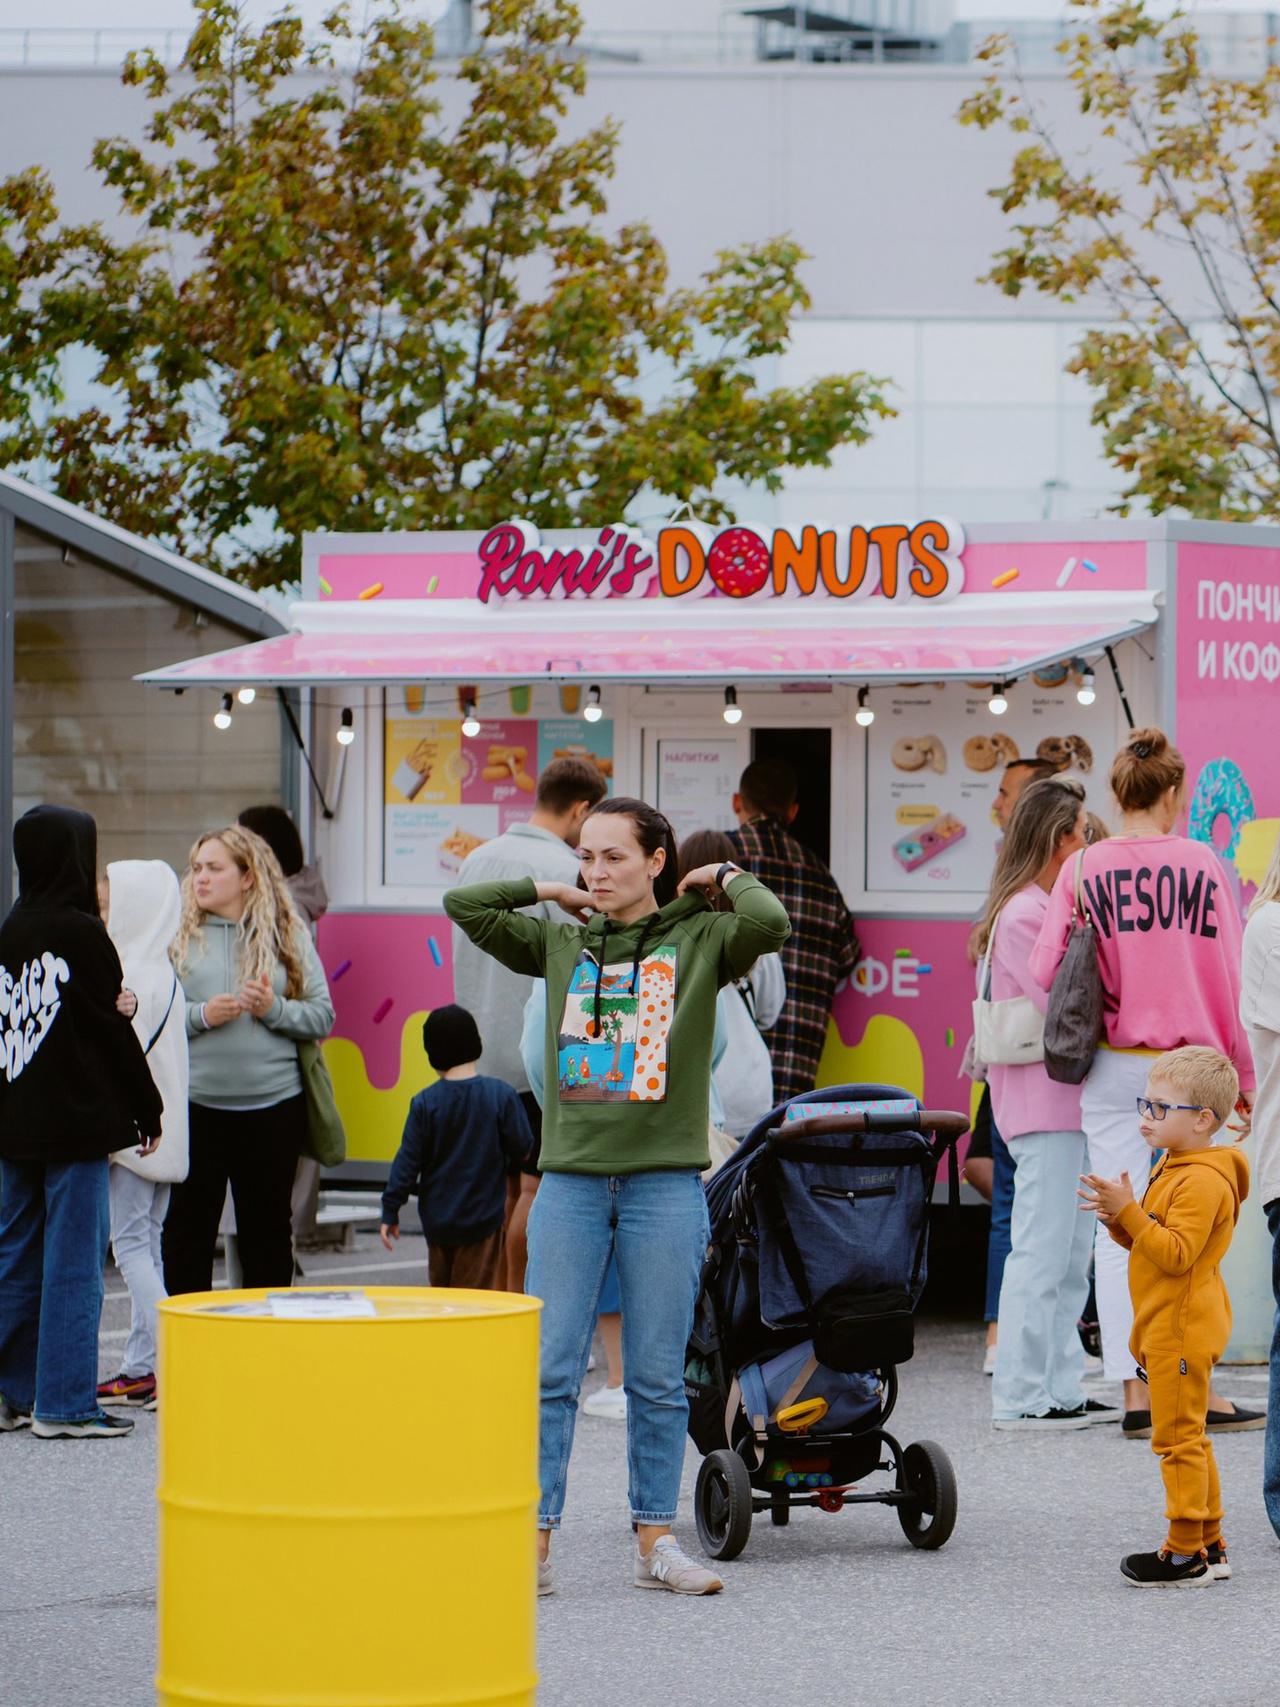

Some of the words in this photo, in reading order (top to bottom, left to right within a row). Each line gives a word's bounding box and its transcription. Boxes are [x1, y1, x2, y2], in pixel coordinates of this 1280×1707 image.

[478, 524, 653, 603] Roni's
[658, 519, 951, 599] DONUTS
[1198, 639, 1217, 680] И
[1083, 865, 1218, 940] WESOME
[0, 951, 70, 1031] eeter
[834, 956, 920, 998] ФЕ
